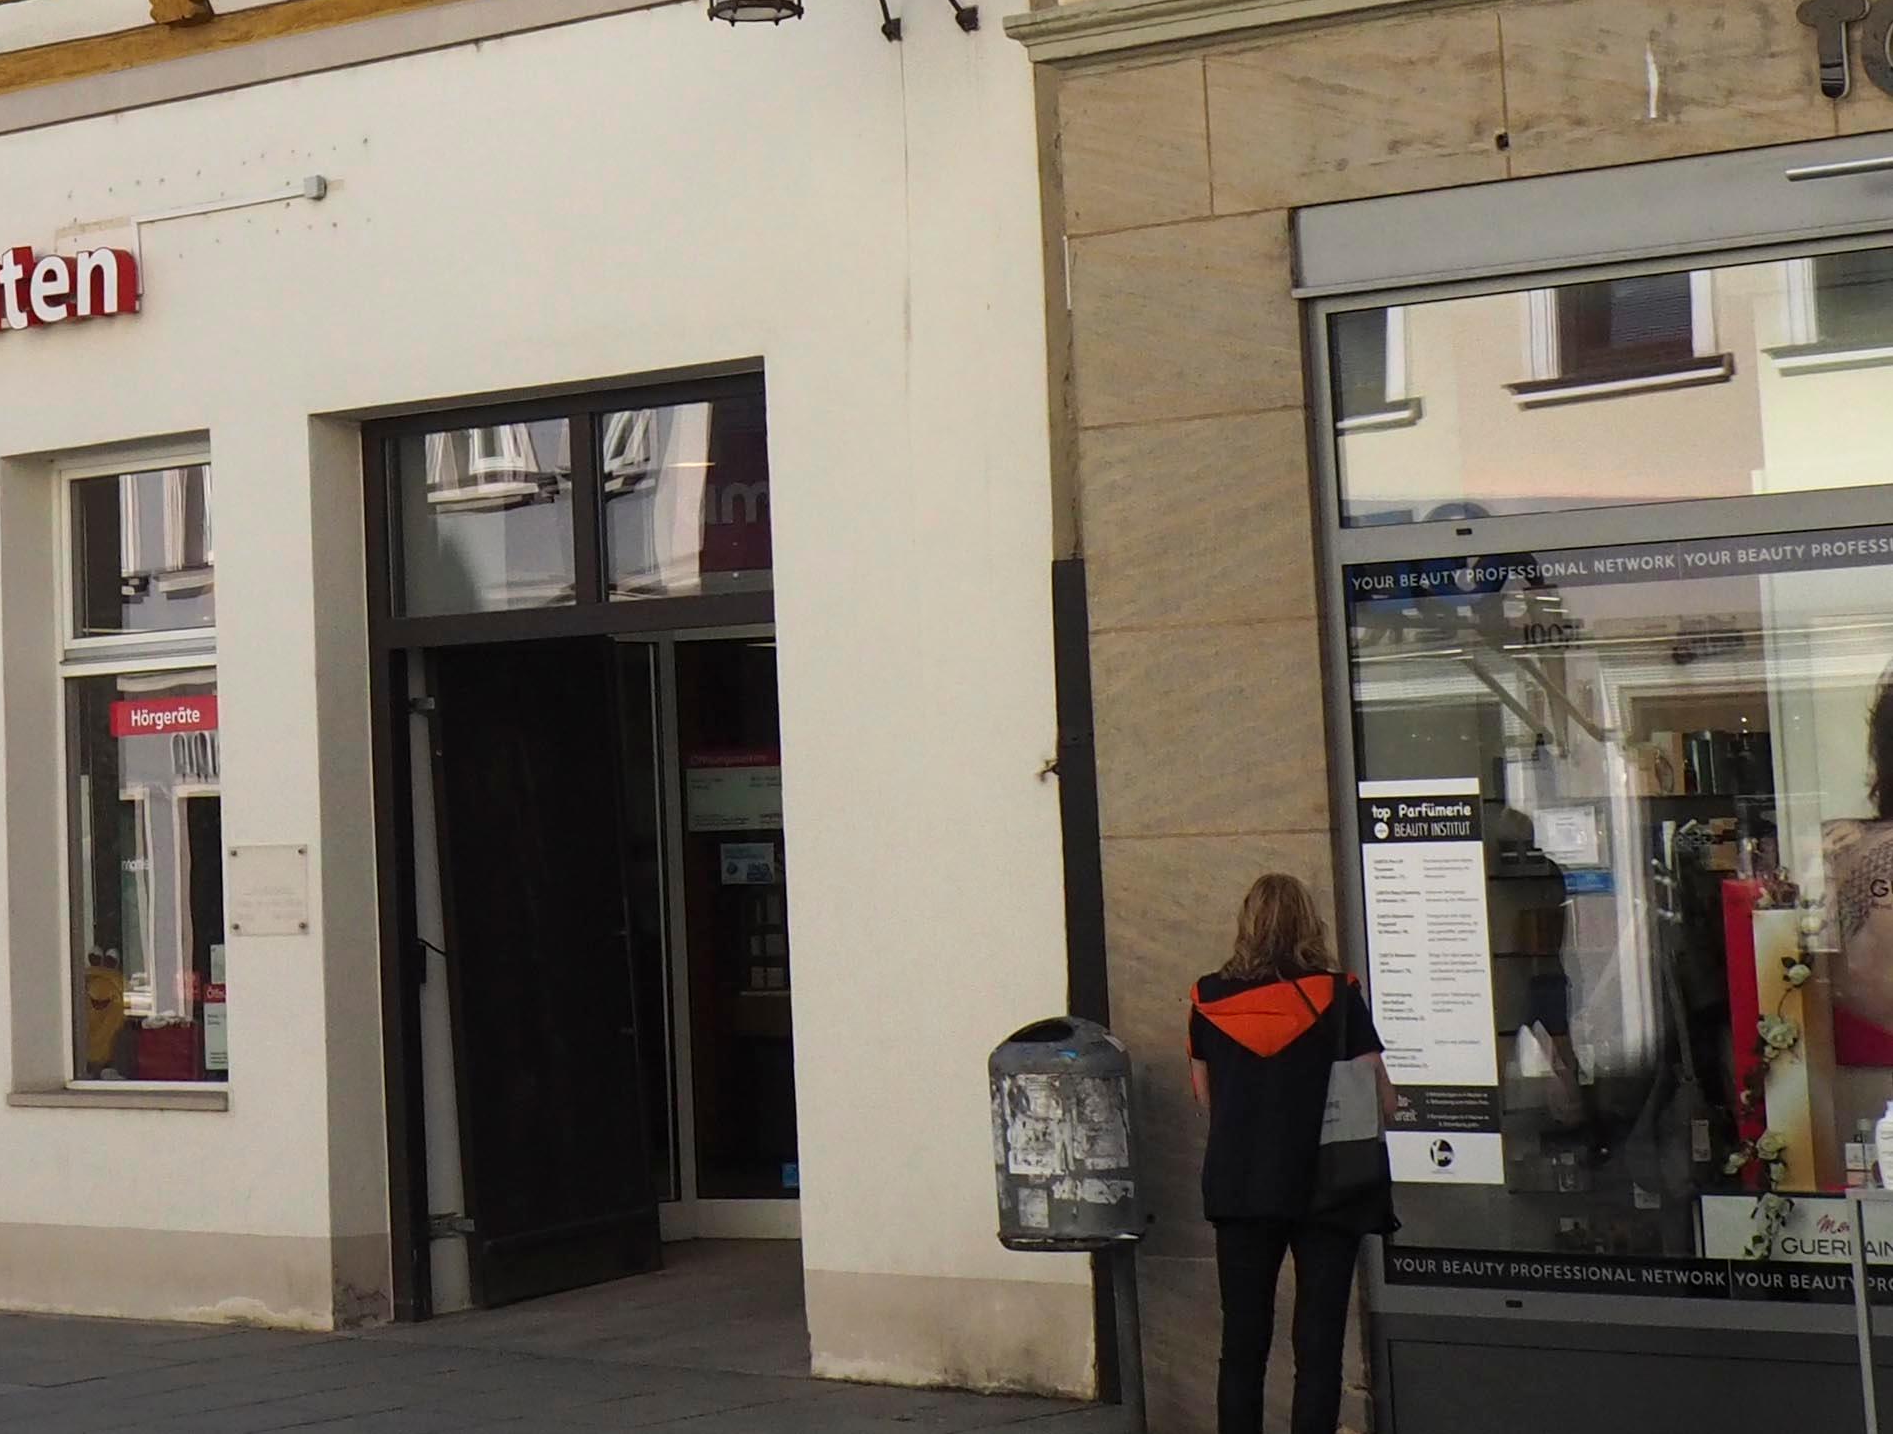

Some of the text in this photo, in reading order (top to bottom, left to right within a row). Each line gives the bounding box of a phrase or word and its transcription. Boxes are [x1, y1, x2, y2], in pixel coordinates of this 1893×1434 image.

[1684, 550, 1732, 567] YOUR
[1737, 544, 1805, 563] BEAUTY
[1352, 555, 1675, 591] YOUR BEAUTY PROFESSIONAL NETWORK
[131, 705, 201, 730] Hörgeräte
[1371, 801, 1472, 821] top Parfümerie
[1394, 820, 1471, 837] BEAUTY INSTITUT
[1393, 1257, 1726, 1286] YOUR BEAUTY PROFESSIONAL NETWORK
[1734, 1272, 1784, 1289] YOUR
